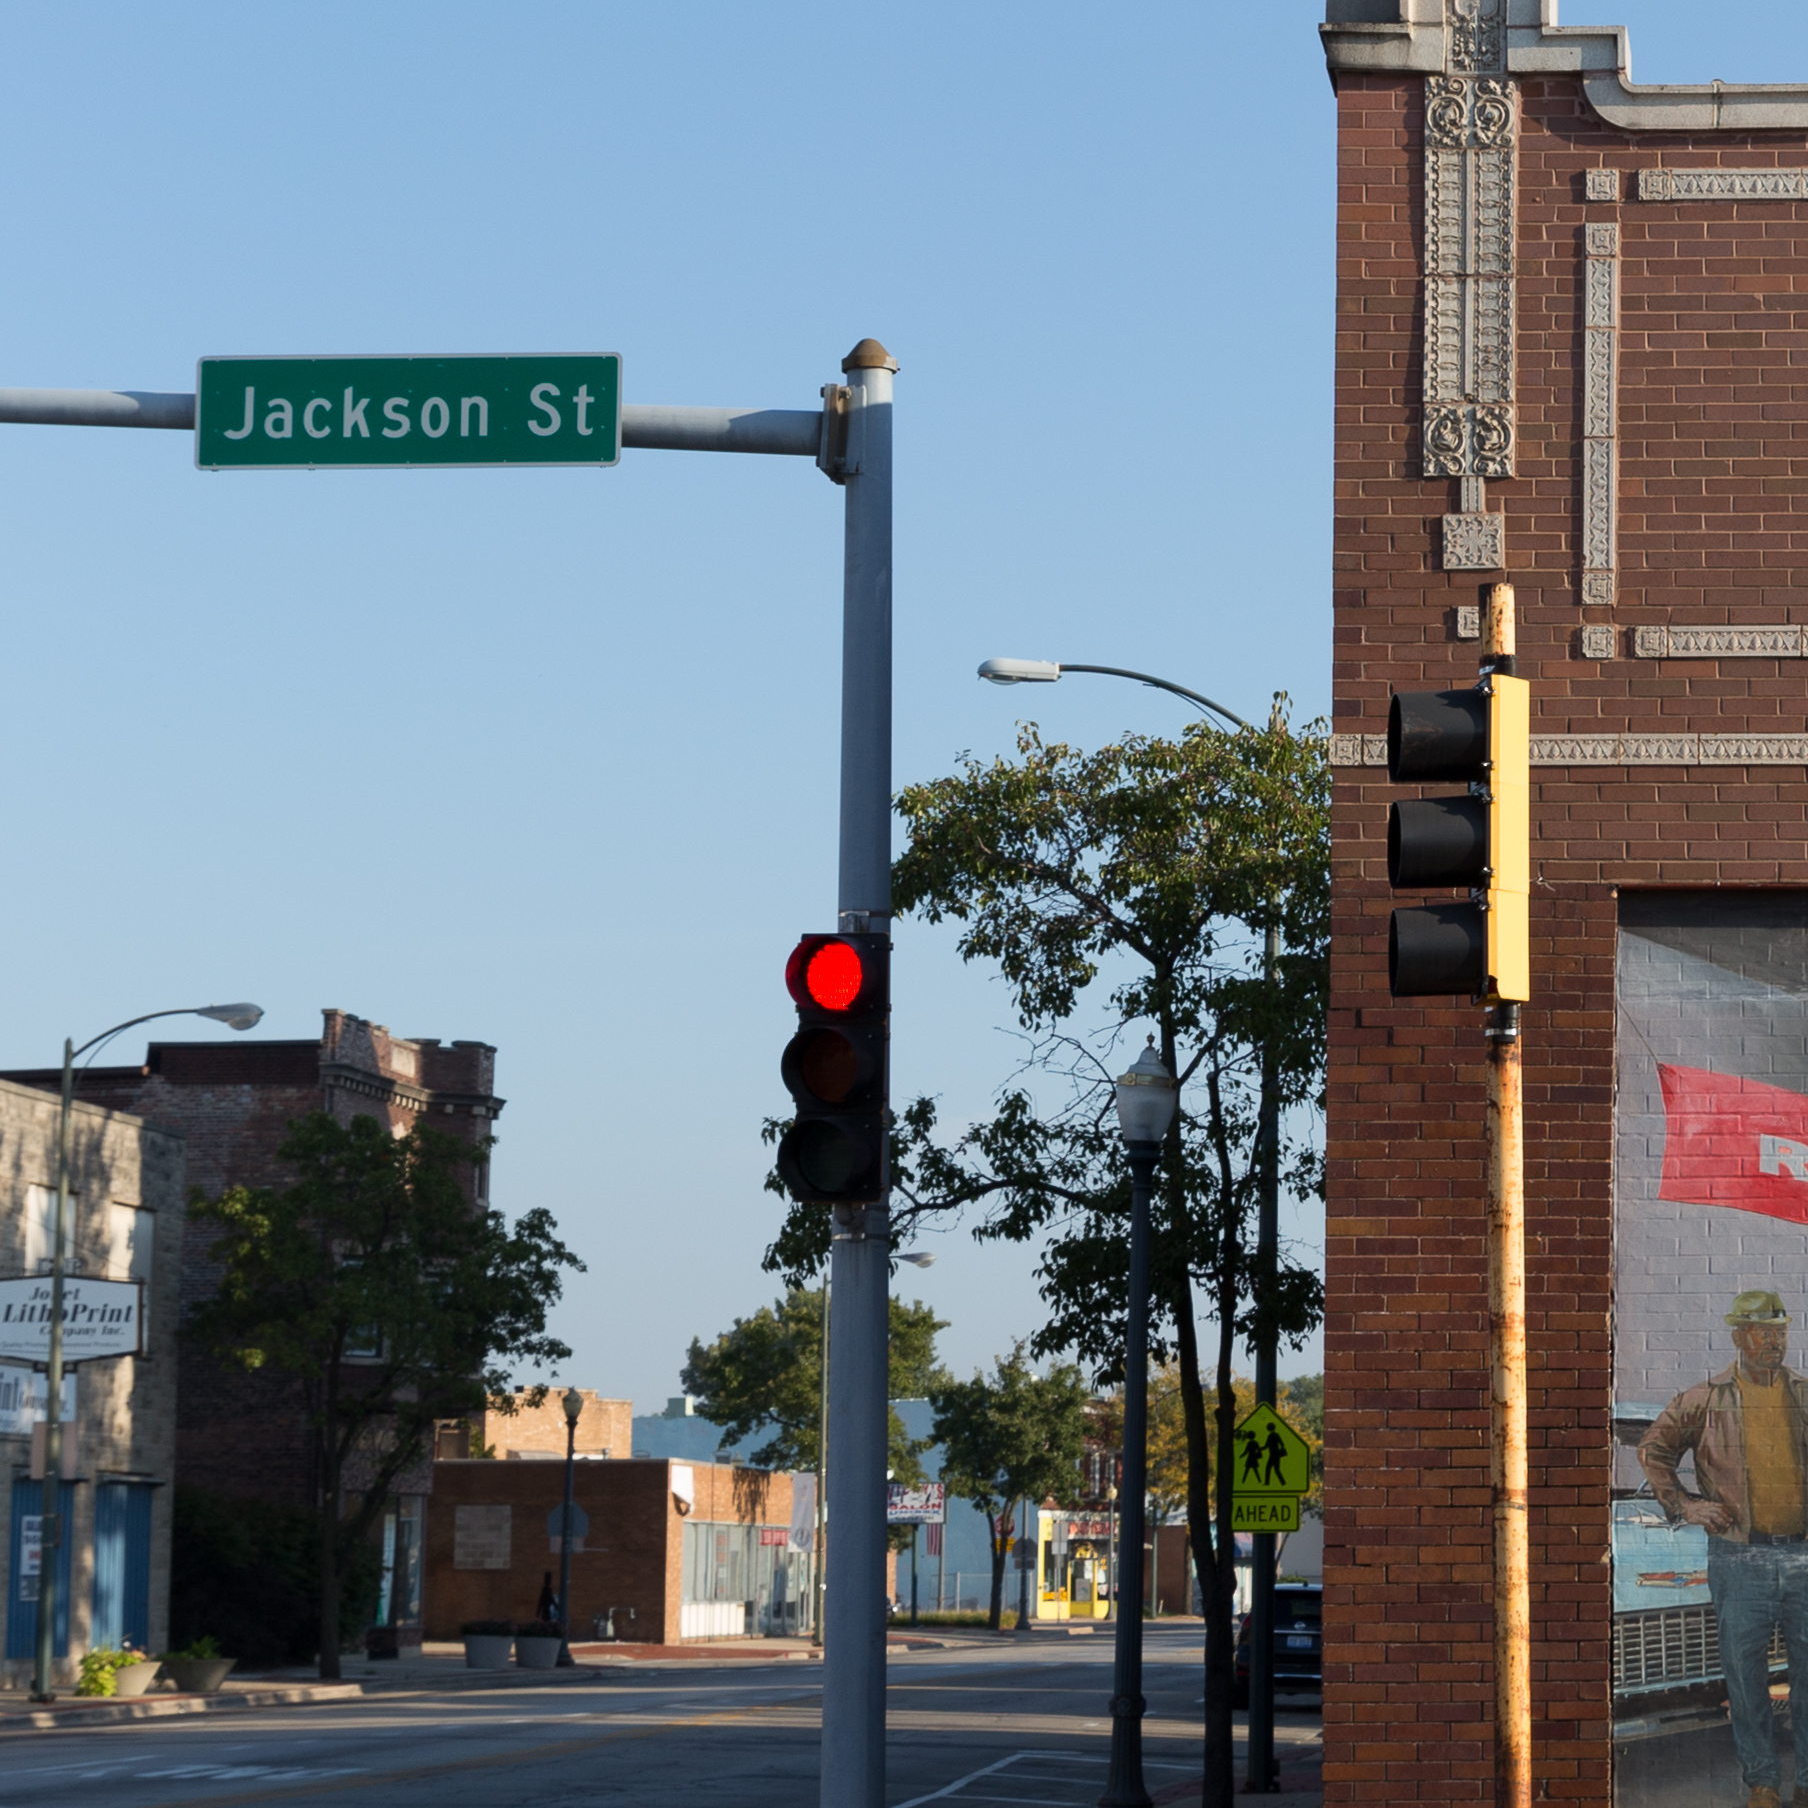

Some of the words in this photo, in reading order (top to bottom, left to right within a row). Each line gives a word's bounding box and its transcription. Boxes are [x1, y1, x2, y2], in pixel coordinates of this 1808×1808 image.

[223, 386, 489, 440] Jackson
[527, 382, 595, 436] St
[1234, 1505, 1291, 1522] AHEAD
